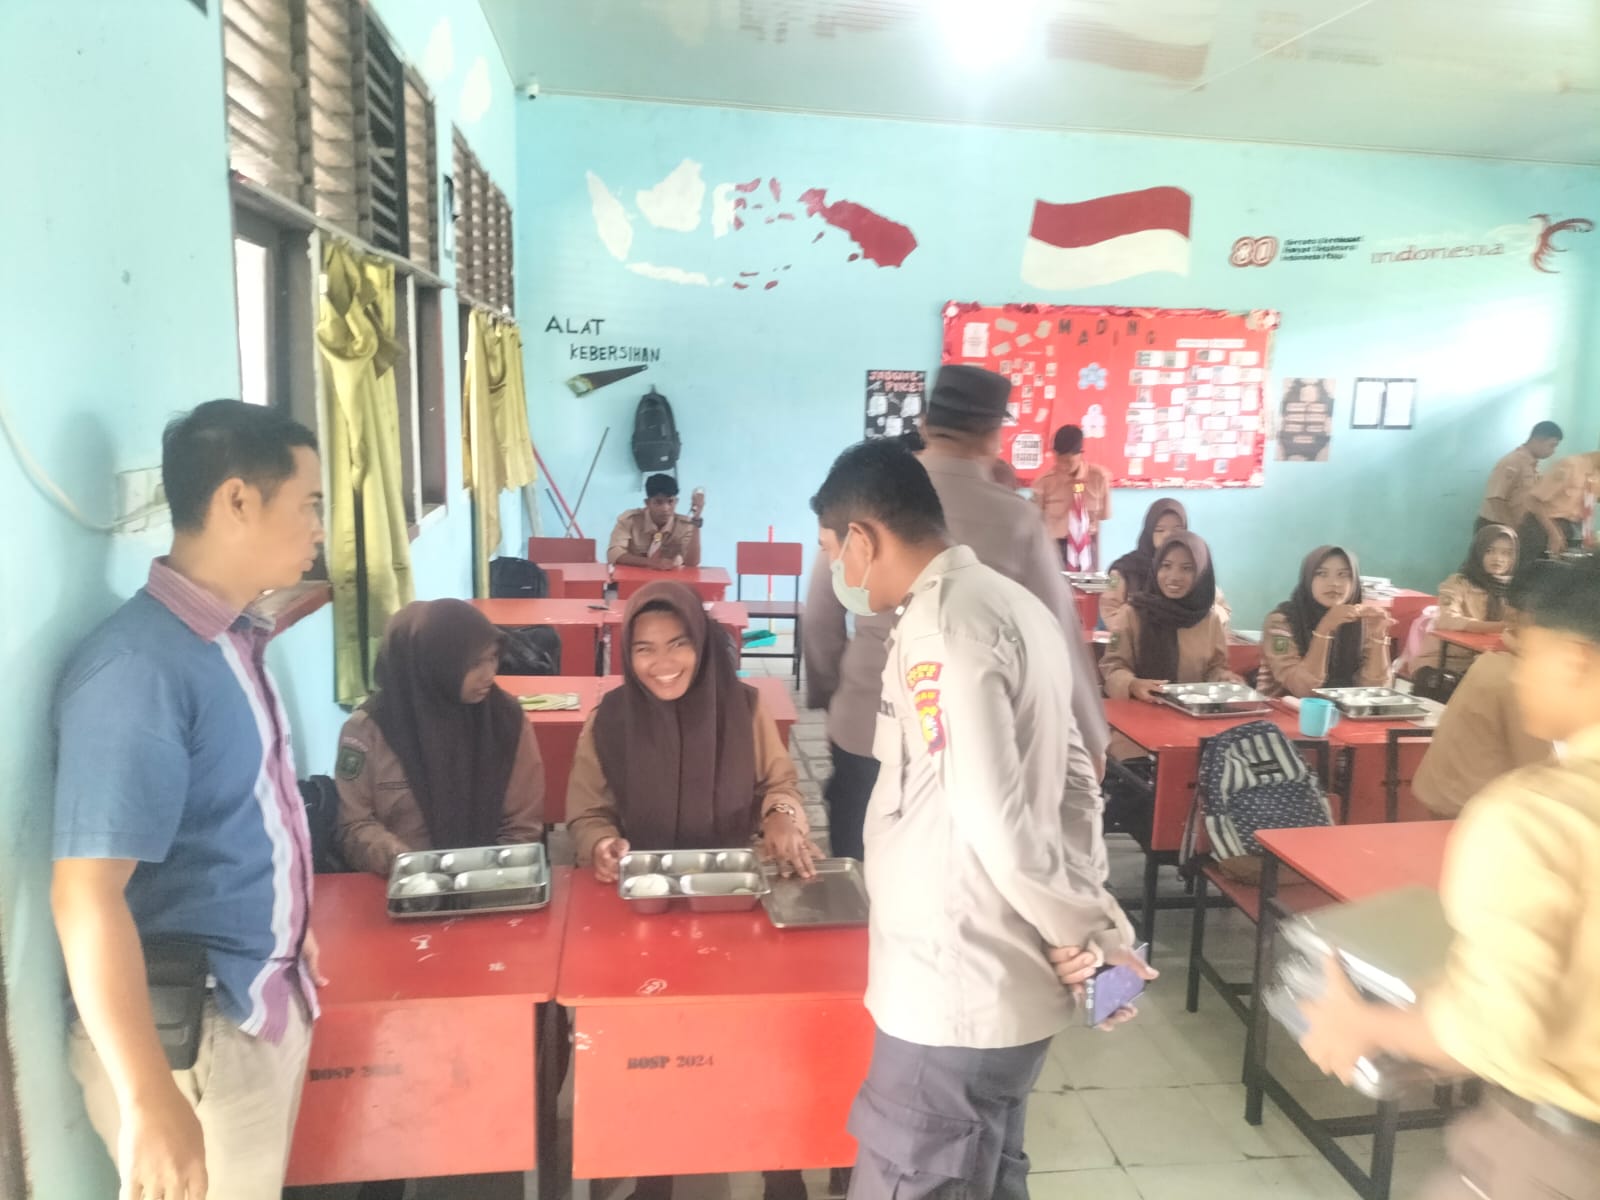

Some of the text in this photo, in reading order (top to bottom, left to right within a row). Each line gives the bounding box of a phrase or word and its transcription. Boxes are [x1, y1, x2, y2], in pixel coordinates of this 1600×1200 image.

[1229, 236, 1278, 267] 80
[544, 315, 606, 336] ALAT
[1058, 319, 1157, 346] MADING
[570, 343, 661, 362] KEBERSIHAN
